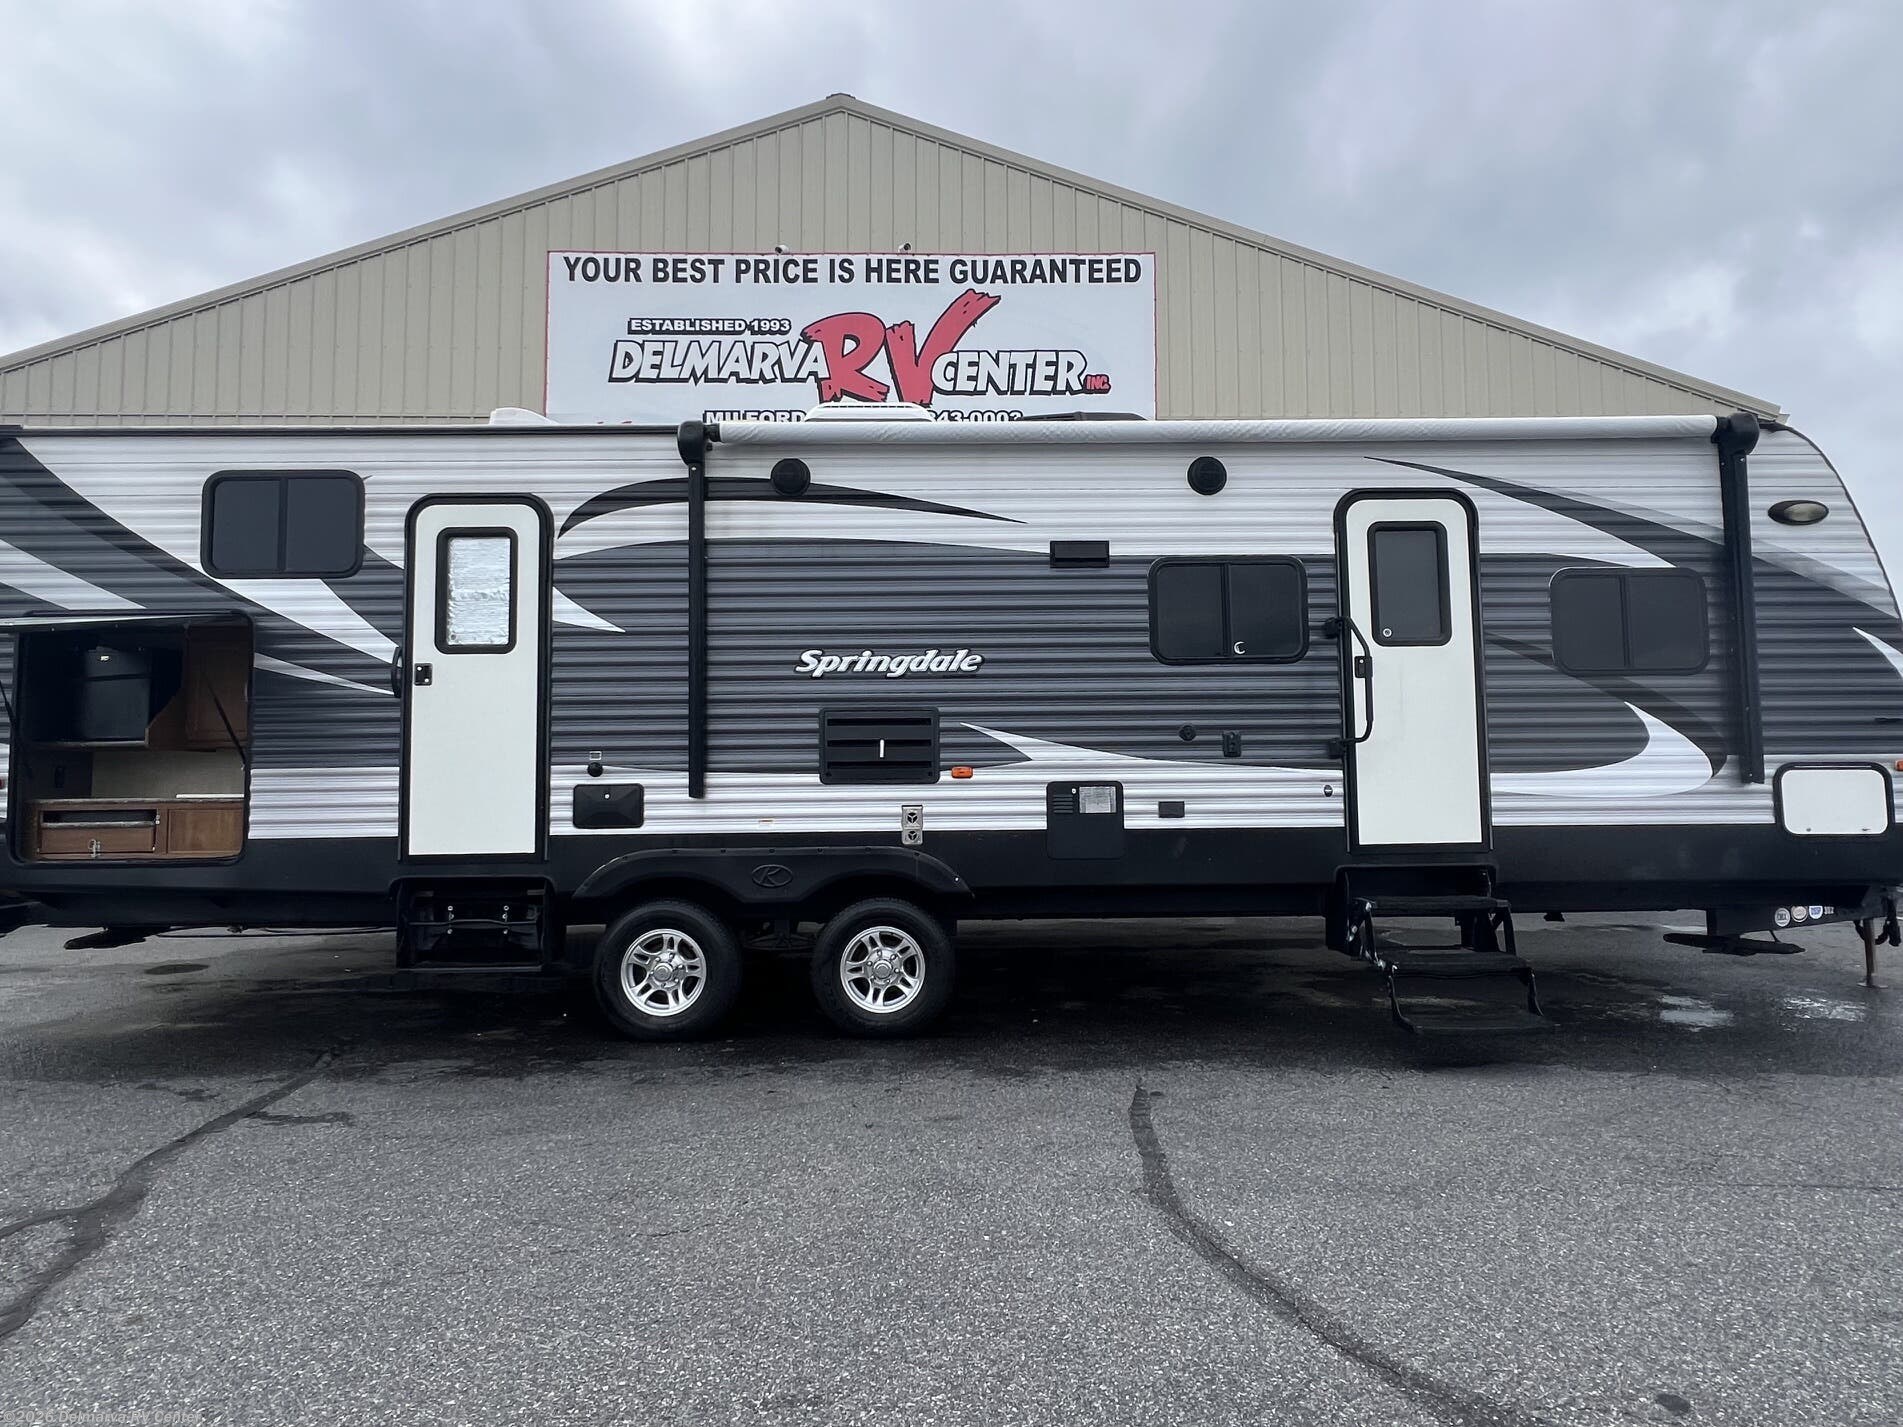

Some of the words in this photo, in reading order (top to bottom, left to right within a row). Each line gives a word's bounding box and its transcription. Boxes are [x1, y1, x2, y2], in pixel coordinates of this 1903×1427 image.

[563, 256, 643, 283] YOUR
[652, 258, 725, 284] BEST
[735, 258, 819, 284] PRICE
[829, 258, 855, 284] IS
[865, 258, 940, 284] HERE
[950, 258, 1143, 284] GUARANTEED
[629, 318, 746, 334] ESTABLISHED
[750, 318, 791, 334] 1993
[609, 340, 831, 385] DELMARVA
[801, 287, 1001, 406] RV
[930, 350, 1088, 395] CENTER
[796, 649, 982, 677] Springdale
